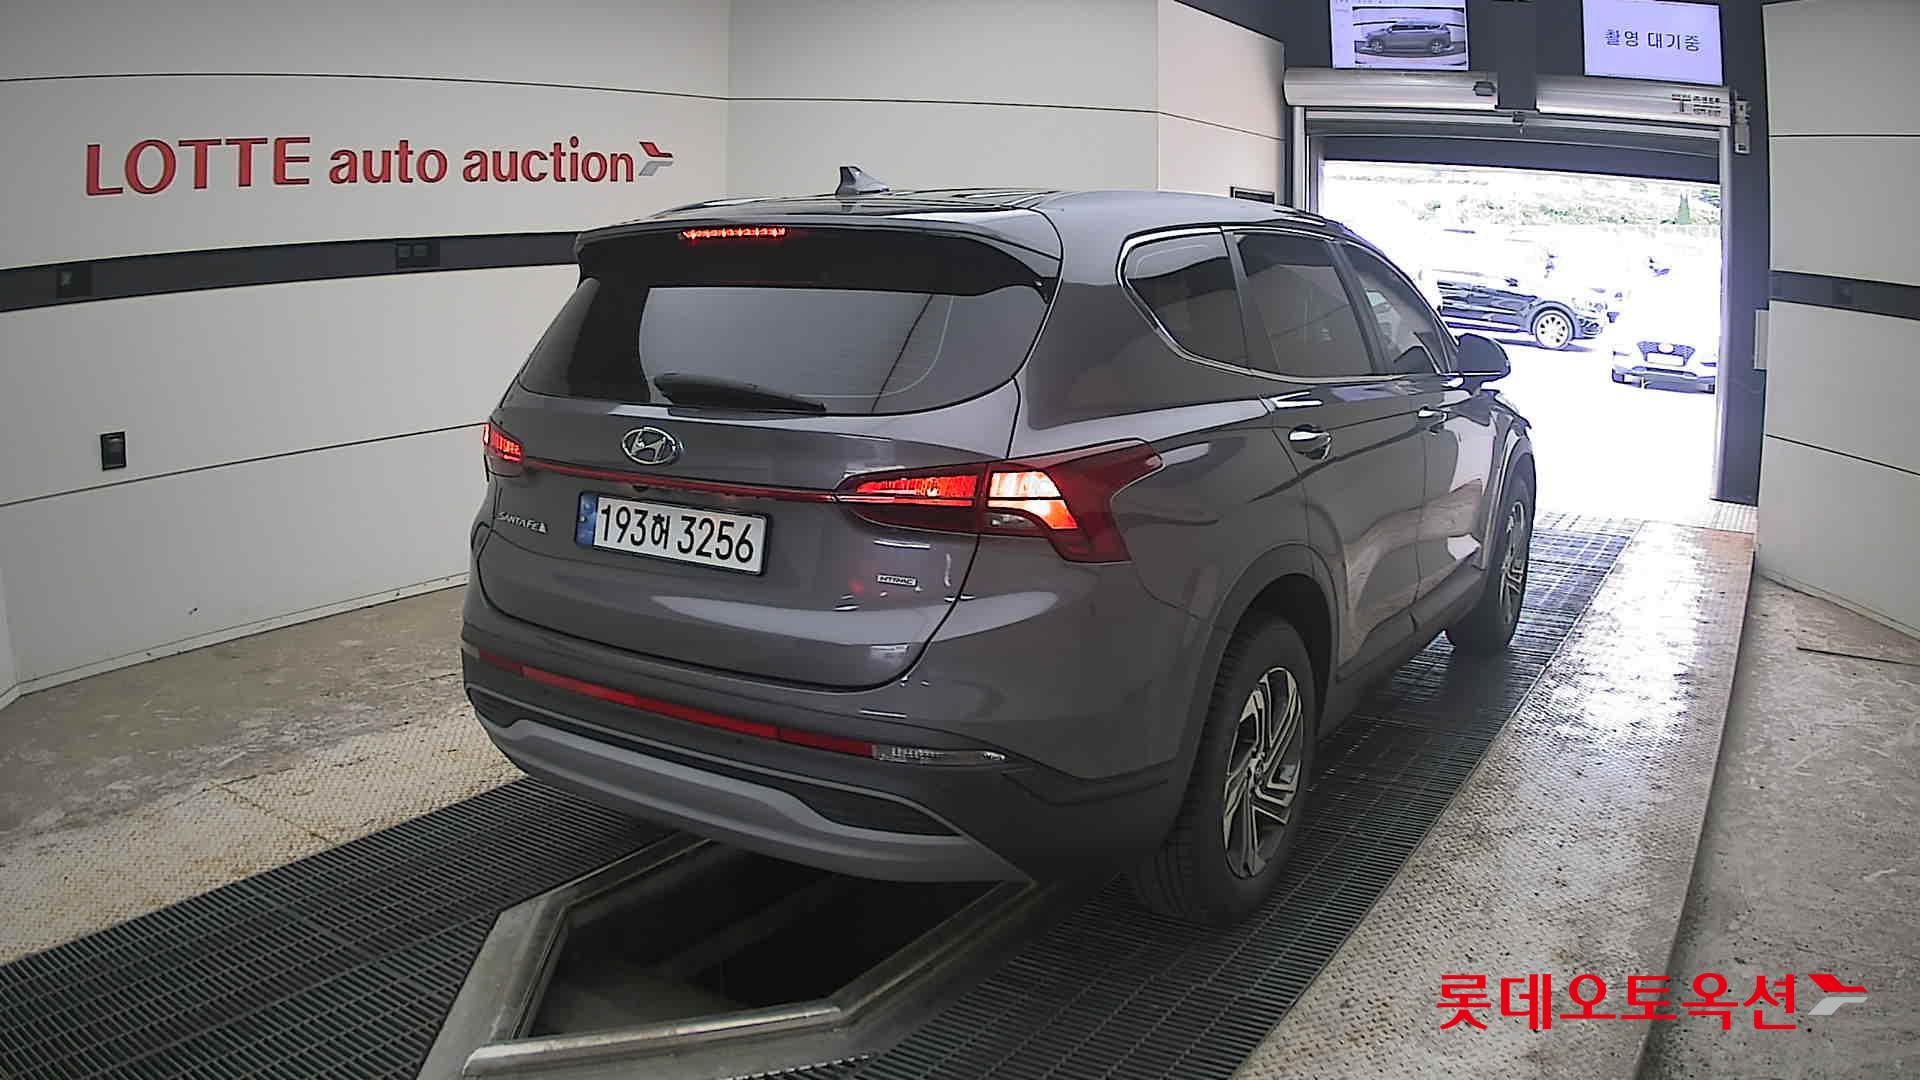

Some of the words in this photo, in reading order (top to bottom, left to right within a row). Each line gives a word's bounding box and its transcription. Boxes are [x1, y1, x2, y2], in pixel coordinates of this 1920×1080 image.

[1604, 29, 1639, 47] 촬영
[1647, 32, 1700, 52] 대기중
[86, 136, 311, 197] LOTTE
[328, 139, 448, 185] auto
[463, 135, 635, 184] auction
[601, 504, 671, 549] 193허
[677, 515, 753, 563] 3256
